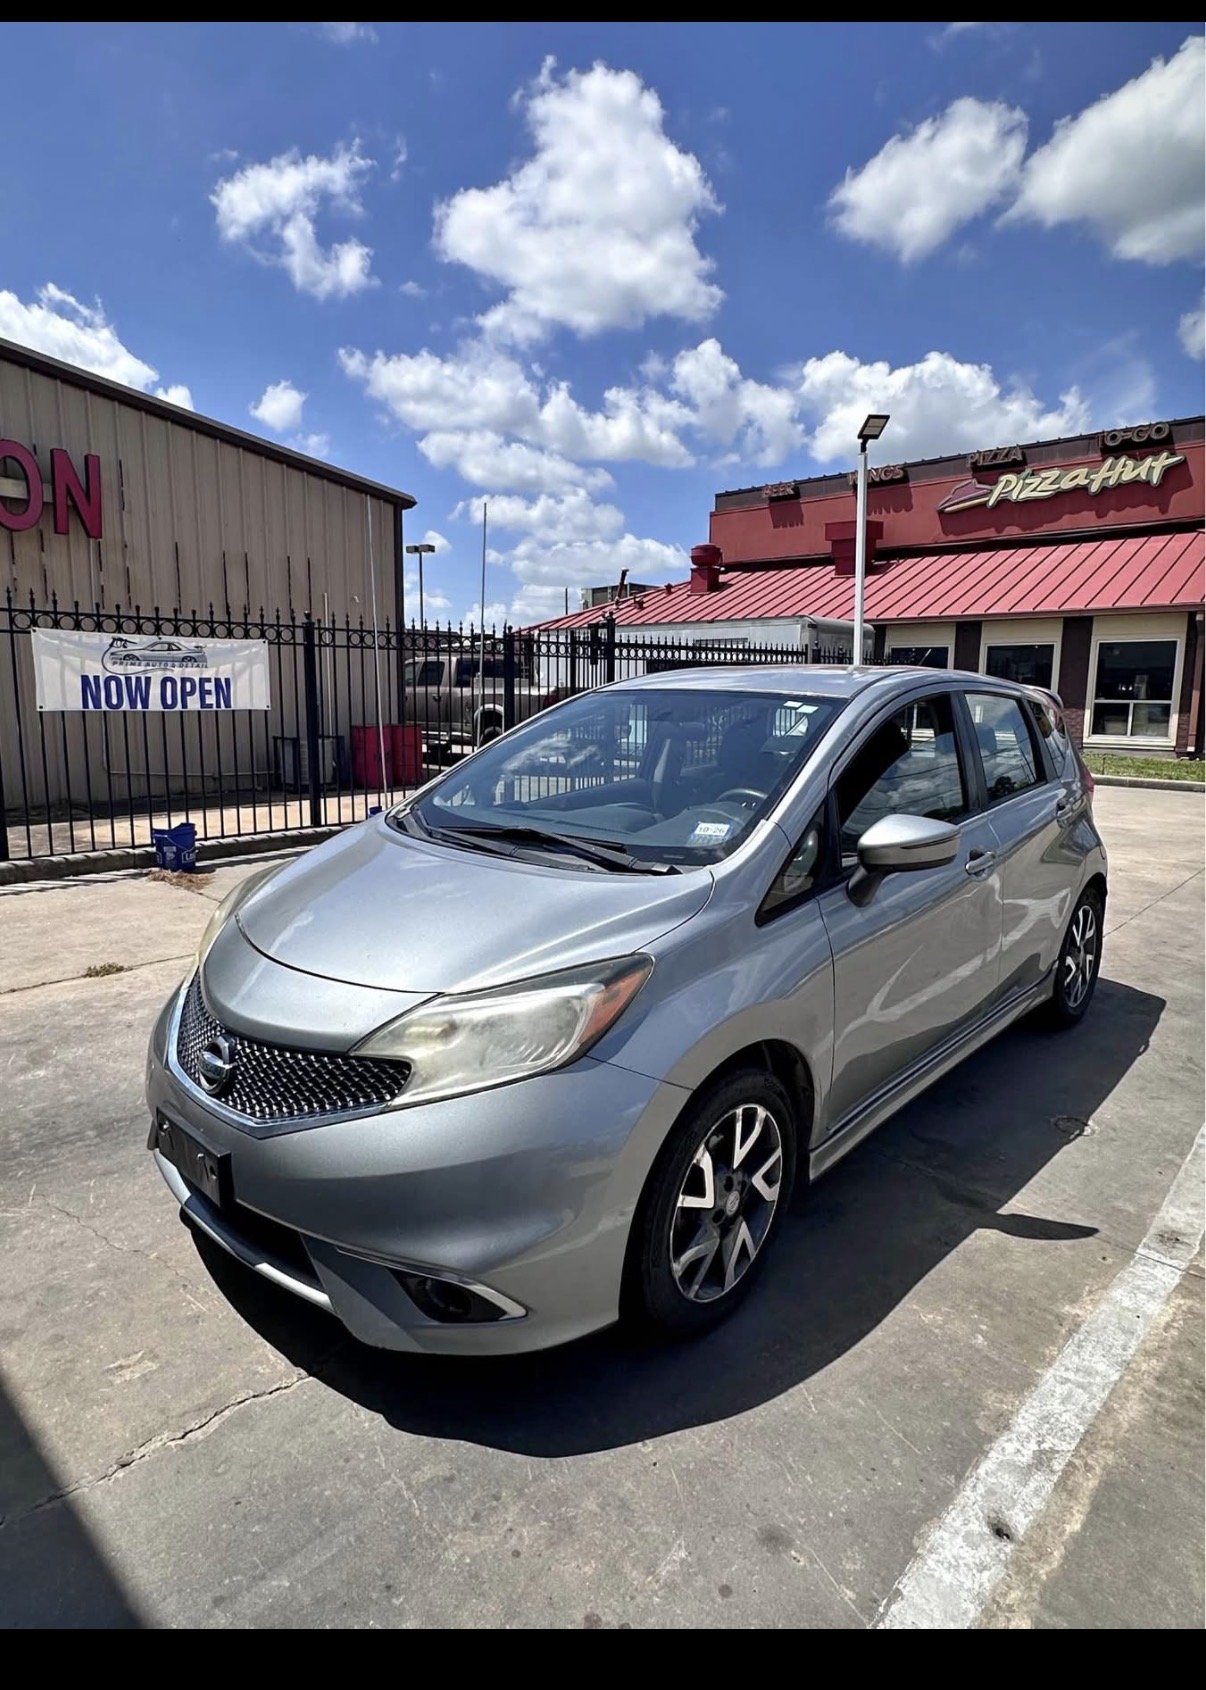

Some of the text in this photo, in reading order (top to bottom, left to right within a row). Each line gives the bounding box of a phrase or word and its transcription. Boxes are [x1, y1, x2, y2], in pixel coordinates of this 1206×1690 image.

[1096, 421, 1170, 448] TO-GO
[966, 446, 1023, 468] PIZZA
[847, 464, 904, 485] WNGS
[761, 482, 795, 498] BEER
[81, 674, 232, 710] NOW OPEN
